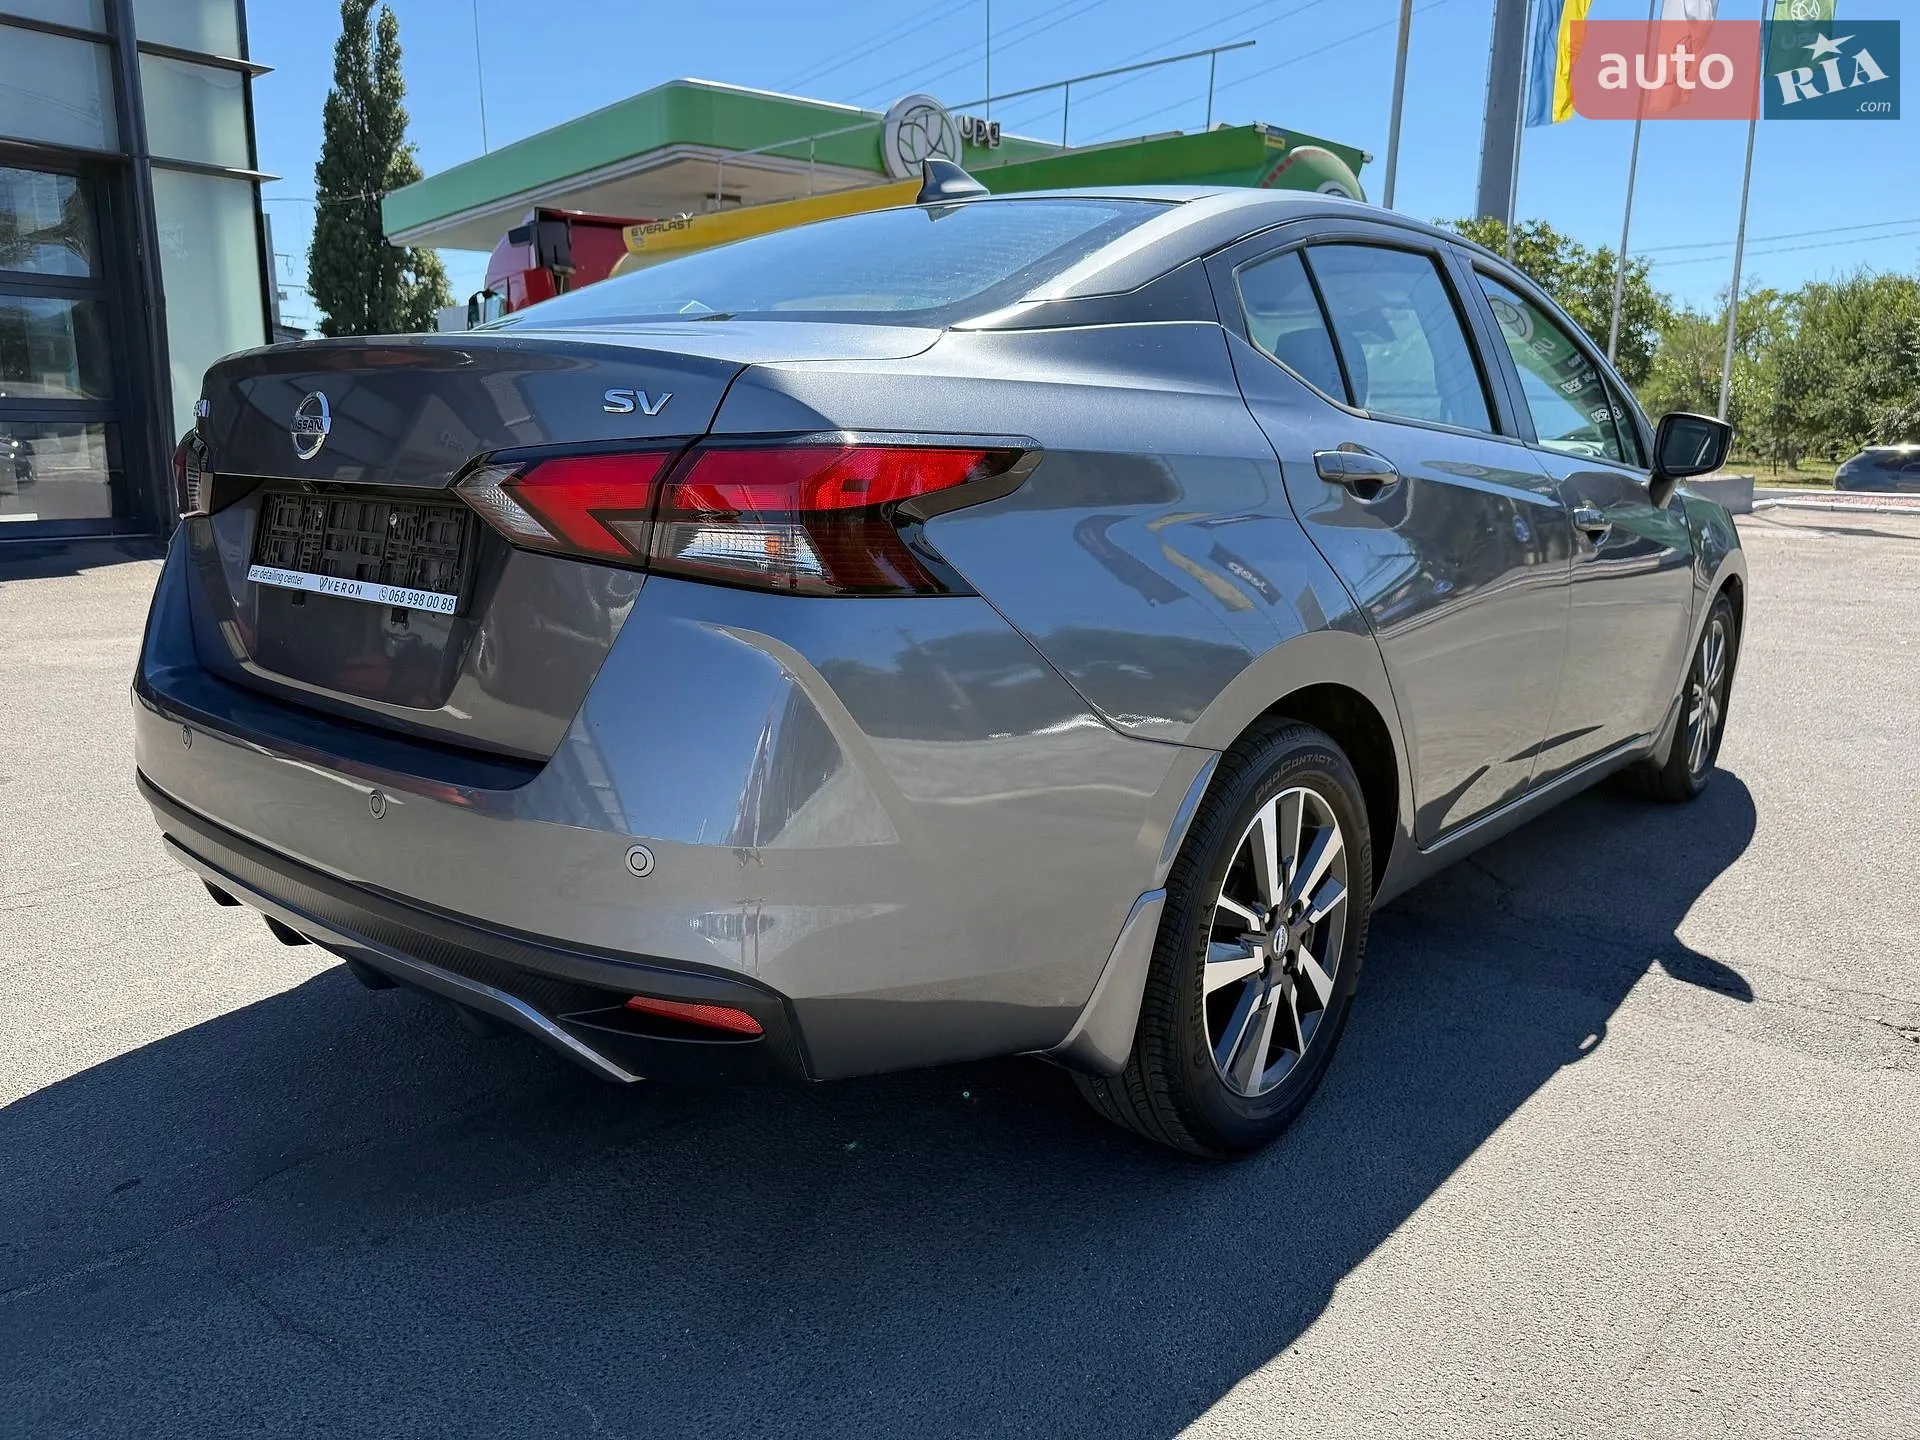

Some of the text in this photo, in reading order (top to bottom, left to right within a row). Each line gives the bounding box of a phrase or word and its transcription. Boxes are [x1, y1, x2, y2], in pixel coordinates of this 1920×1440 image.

[955, 115, 1001, 149] upg
[631, 218, 693, 237] EVERLAST
[603, 389, 673, 416] SV
[250, 569, 260, 579] car
[284, 574, 304, 585] center
[328, 579, 363, 596] VERON
[388, 589, 455, 611] 068 998 00 88
